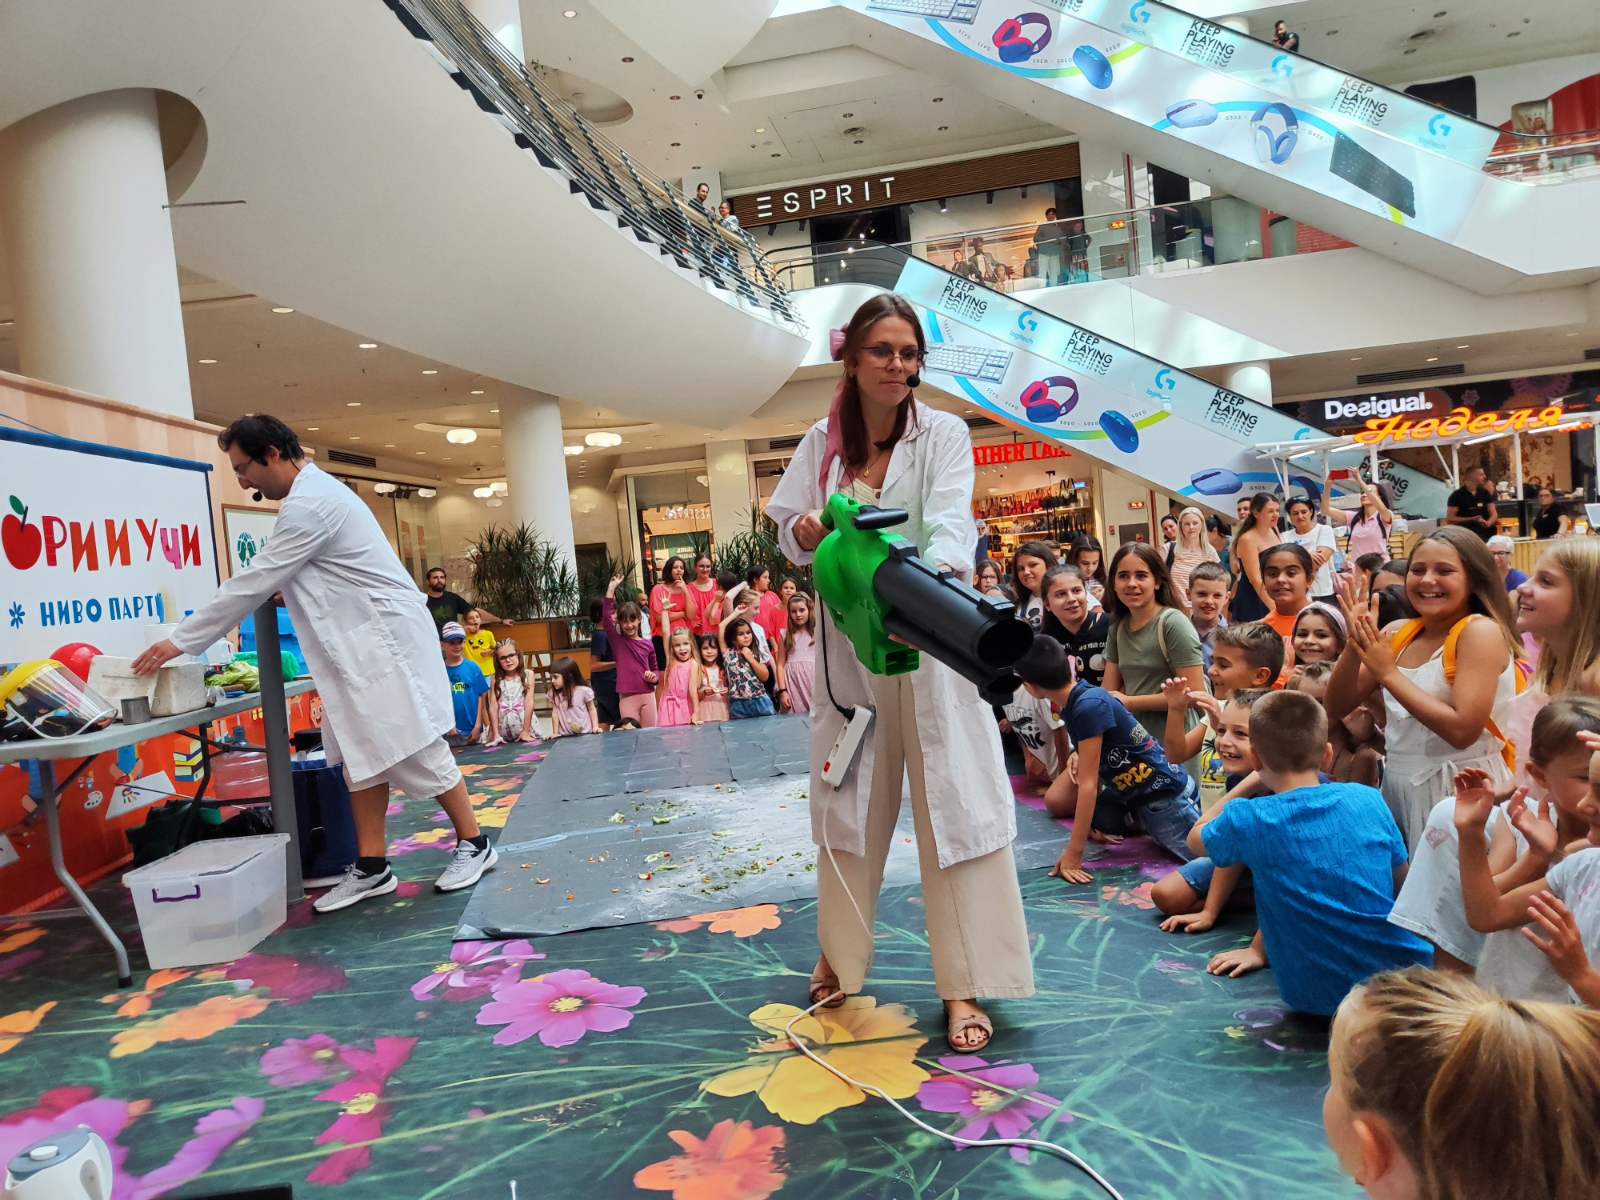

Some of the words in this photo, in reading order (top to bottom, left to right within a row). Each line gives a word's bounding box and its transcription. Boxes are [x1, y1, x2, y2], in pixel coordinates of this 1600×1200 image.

[1191, 19, 1221, 37] KEEP
[1186, 29, 1234, 56] PLAYING
[1341, 76, 1373, 95] KEEP
[1337, 87, 1388, 115] PLAYING
[756, 177, 896, 218] ESPRIT
[948, 276, 975, 293] KEEP
[943, 286, 988, 312] PLAYING
[1067, 338, 1113, 366] PLAYING
[1071, 329, 1100, 347] KEEP
[1214, 389, 1245, 407] KEEP
[1210, 398, 1258, 427] PLAYING
[1354, 405, 1564, 445] Неделя
[105, 518, 131, 568] И
[136, 517, 202, 570] УЧИ
[39, 597, 103, 628] НИВО
[1111, 762, 1154, 792] EPIC
